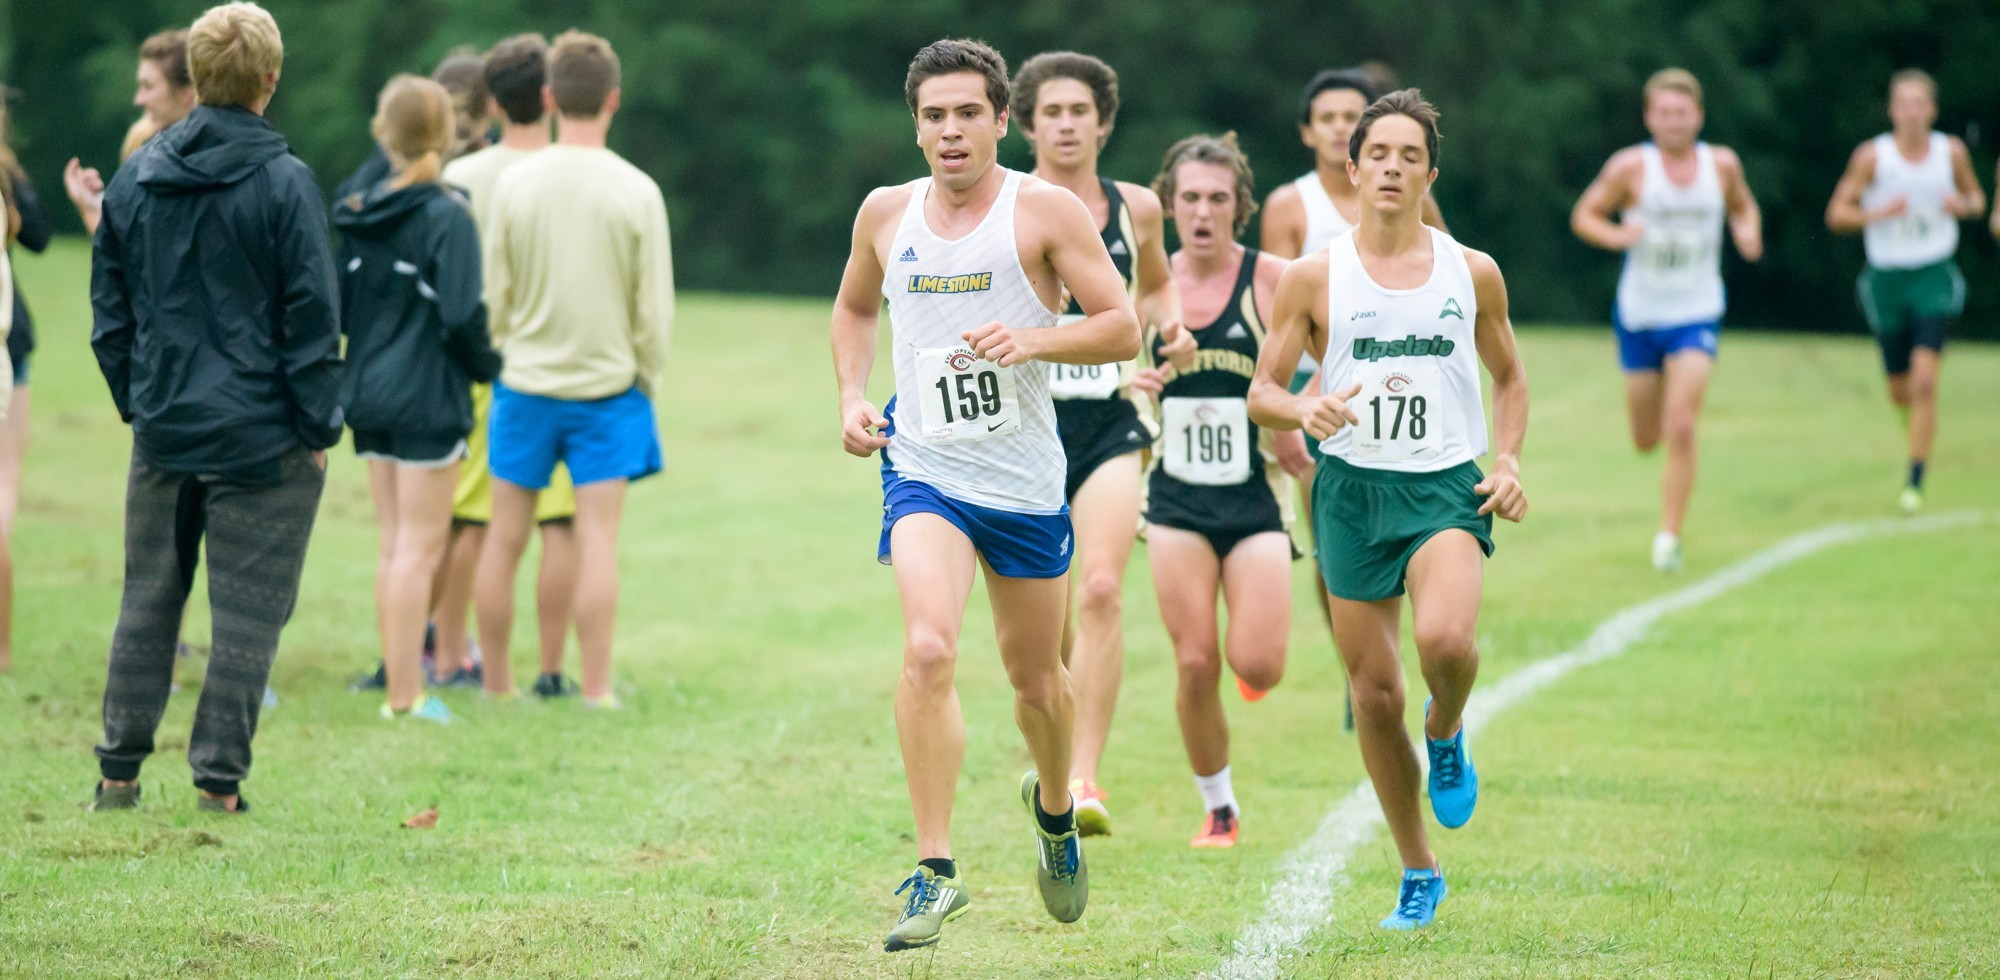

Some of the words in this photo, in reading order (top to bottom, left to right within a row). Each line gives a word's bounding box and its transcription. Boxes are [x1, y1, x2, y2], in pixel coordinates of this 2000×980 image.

[908, 272, 992, 293] LIMESTONE
[1352, 334, 1455, 362] Upstate
[936, 370, 1002, 423] 159
[1369, 395, 1427, 441] 178
[1183, 424, 1233, 464] 196
